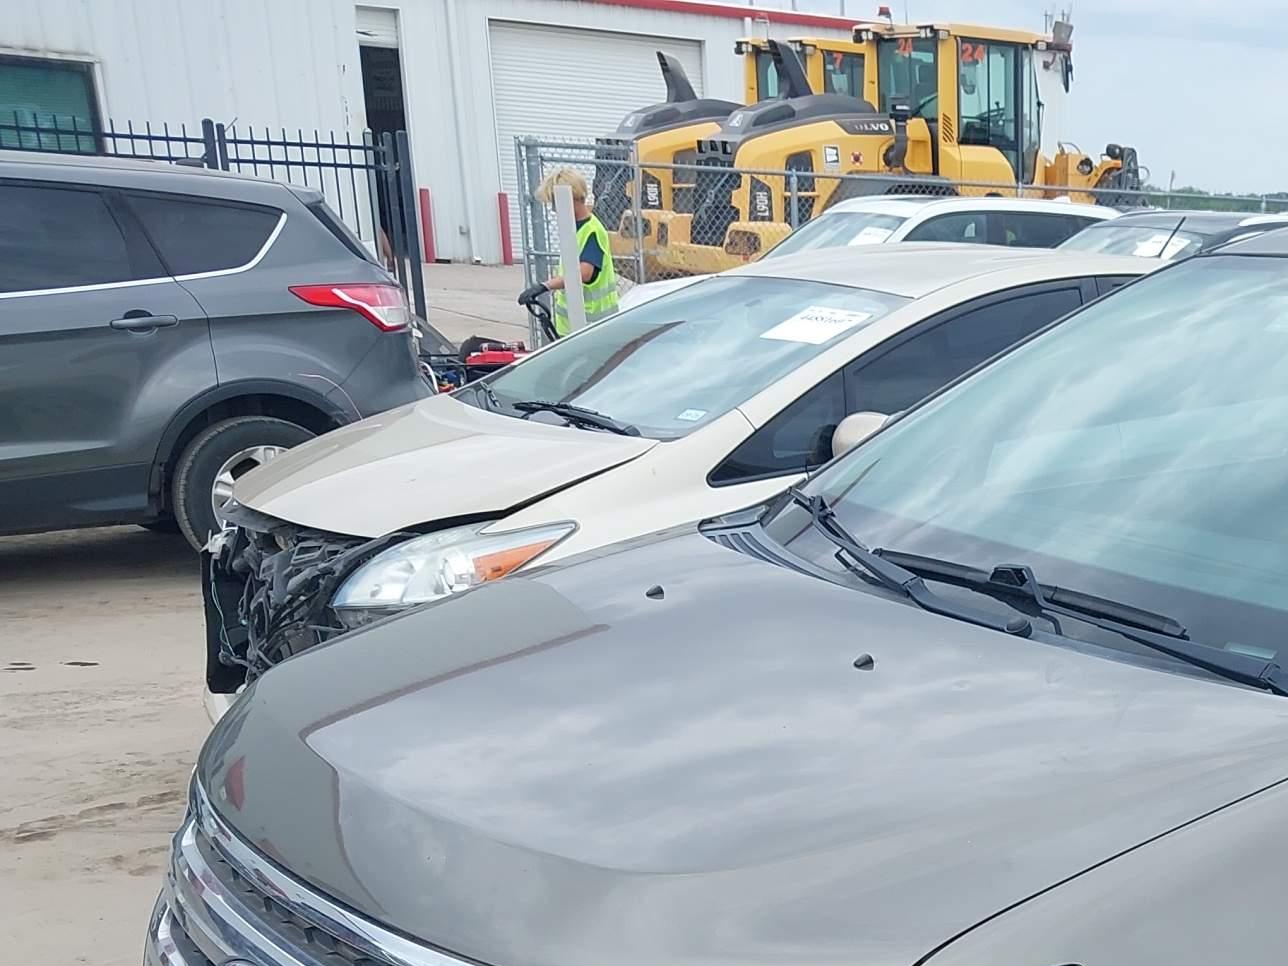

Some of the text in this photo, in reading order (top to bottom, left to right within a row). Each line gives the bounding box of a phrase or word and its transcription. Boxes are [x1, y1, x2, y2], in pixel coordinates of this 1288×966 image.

[832, 52, 843, 69] 7
[961, 43, 986, 64] 24
[646, 183, 659, 206] L90H
[756, 191, 769, 217] L90H
